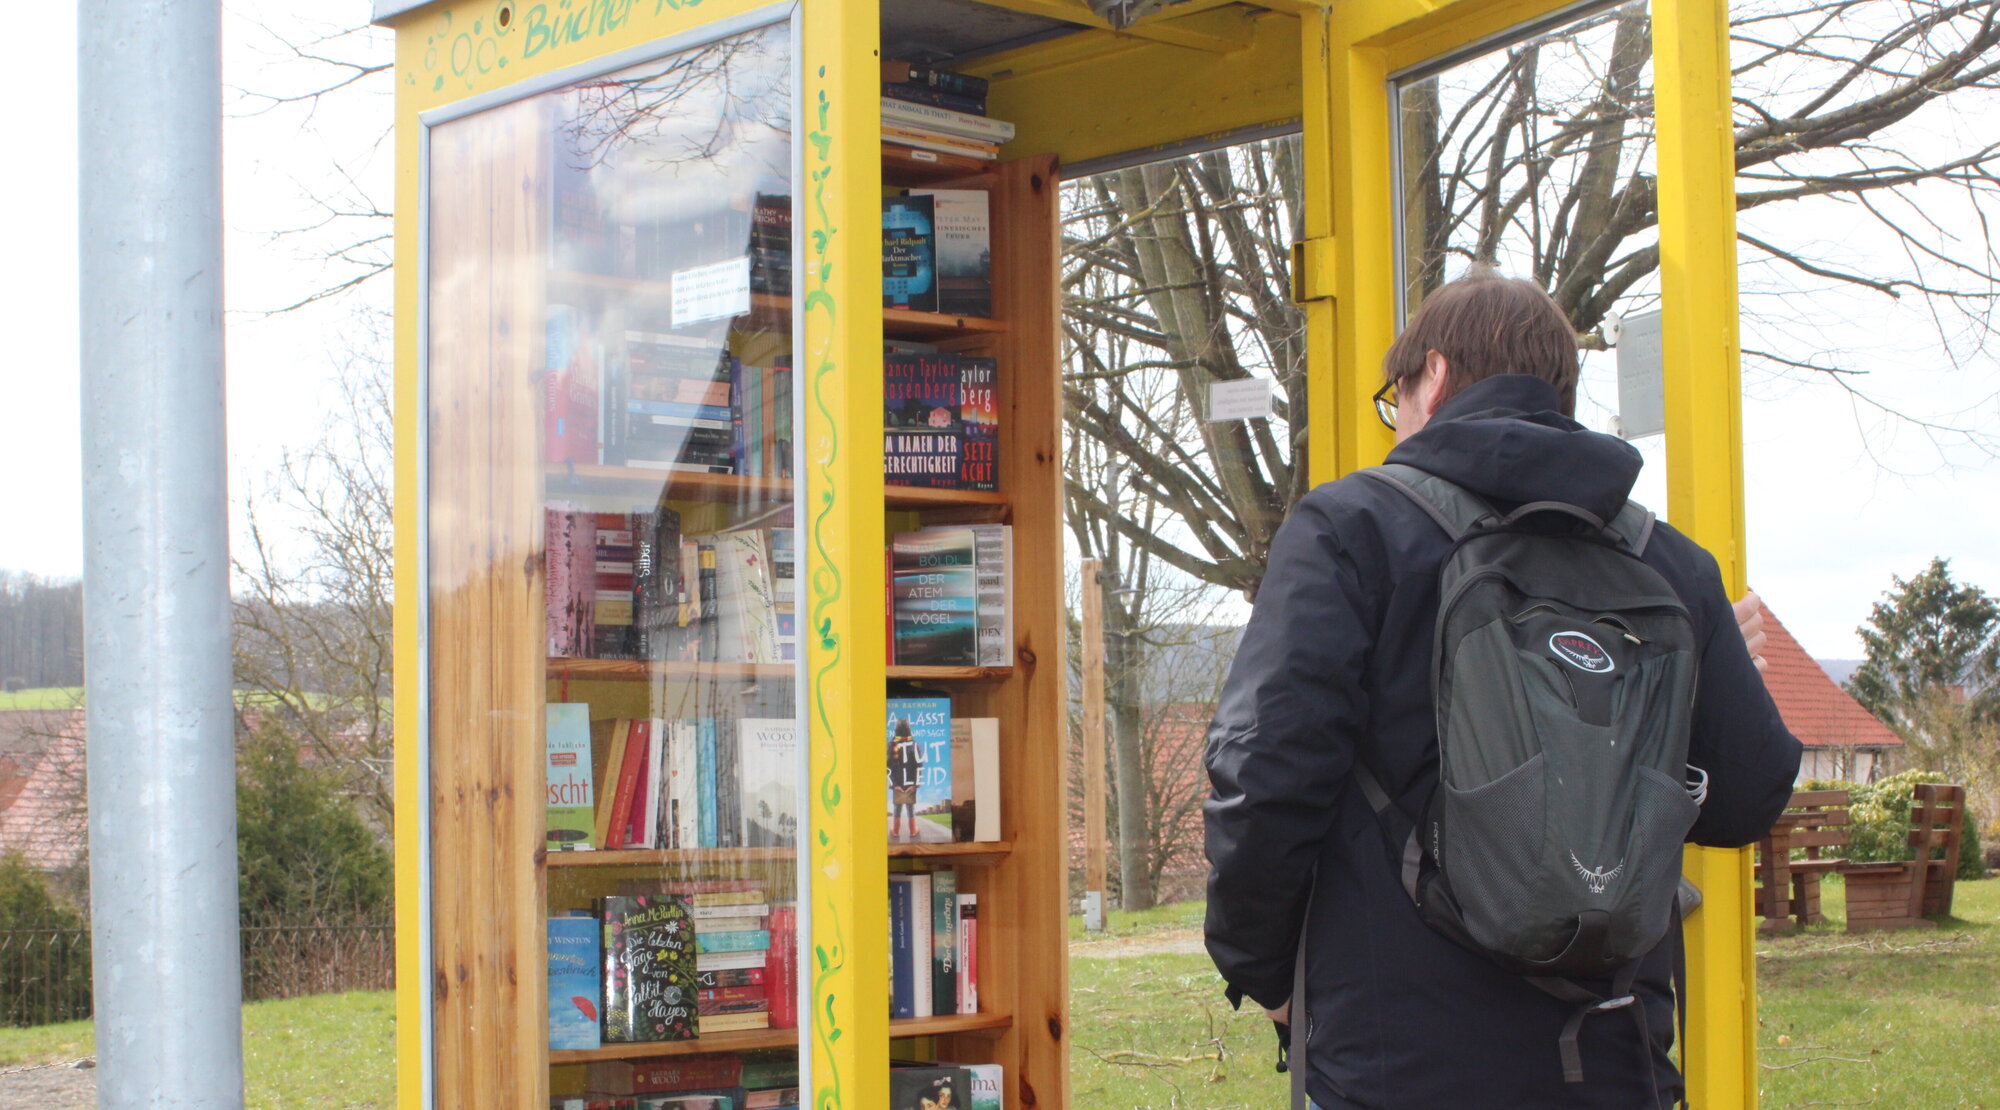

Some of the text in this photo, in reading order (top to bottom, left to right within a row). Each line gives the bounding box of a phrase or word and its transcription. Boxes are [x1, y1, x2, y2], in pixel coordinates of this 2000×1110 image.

[521, 0, 632, 59] Bücher
[898, 103, 923, 115] ANIMAL
[882, 253, 922, 262] arktmacher
[893, 246, 906, 254] Der
[919, 358, 956, 383] Taylor
[961, 364, 991, 388] aylor
[961, 382, 991, 413] berg
[884, 435, 957, 453] M NAMEN DER
[963, 442, 993, 461] SETZ
[961, 462, 993, 481] ACHT
[639, 541, 651, 578] Silber
[918, 574, 945, 585] DER
[908, 587, 943, 599] ATEM
[930, 600, 957, 611] DER
[911, 612, 954, 625] VÖGEL
[1557, 636, 1603, 657] OSPREY
[907, 711, 946, 725] LÄSST
[927, 729, 945, 737] SAGT
[897, 740, 946, 764] TUT
[903, 767, 947, 786] LEID
[623, 905, 684, 927] Anna McPartlin
[554, 936, 592, 944] WINSTON
[647, 931, 684, 950] letzten
[620, 948, 655, 974] Tage
[942, 951, 954, 974] Die
[648, 969, 668, 979] von
[647, 998, 688, 1026] Hayes
[651, 1075, 680, 1085] WOOD
